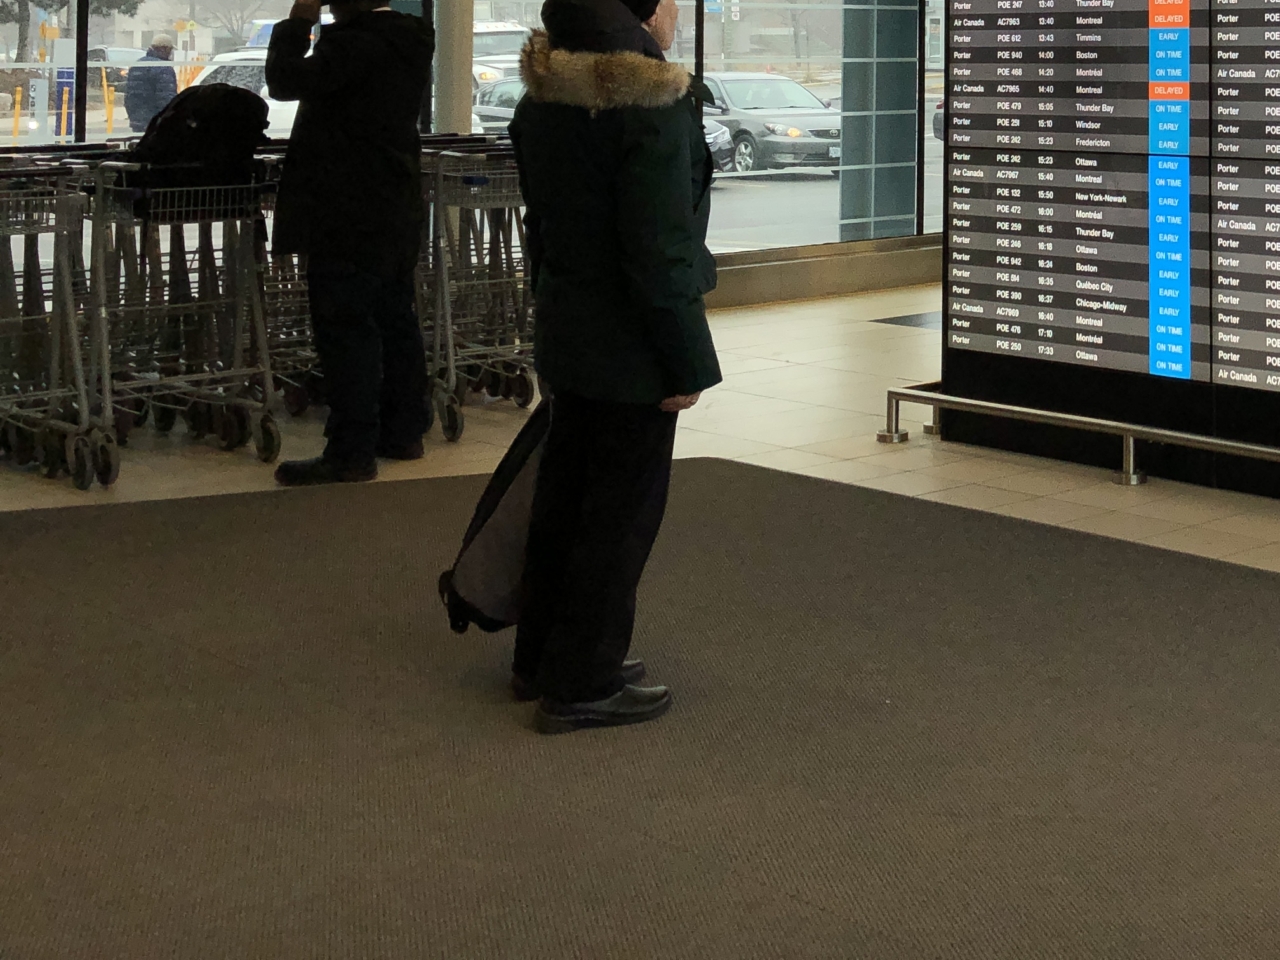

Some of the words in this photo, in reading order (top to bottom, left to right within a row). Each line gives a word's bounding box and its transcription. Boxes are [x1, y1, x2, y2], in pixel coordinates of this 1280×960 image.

[1217, 32, 1238, 42] Porter
[1265, 31, 1280, 41] POE
[954, 51, 971, 60] Porter
[997, 51, 1010, 60] POE
[1039, 50, 1054, 60] 14:00
[1076, 50, 1098, 60] Boston
[1155, 50, 1165, 59] ON
[1167, 50, 1182, 59] TIME
[1217, 106, 1239, 117] Porter
[1265, 108, 1280, 118] POE
[1218, 332, 1239, 343] Porter
[952, 335, 970, 345] Porter
[997, 340, 1009, 350] POE
[1076, 350, 1098, 362] Ottawa
[1156, 361, 1166, 371] ON
[1168, 361, 1183, 372] TIME
